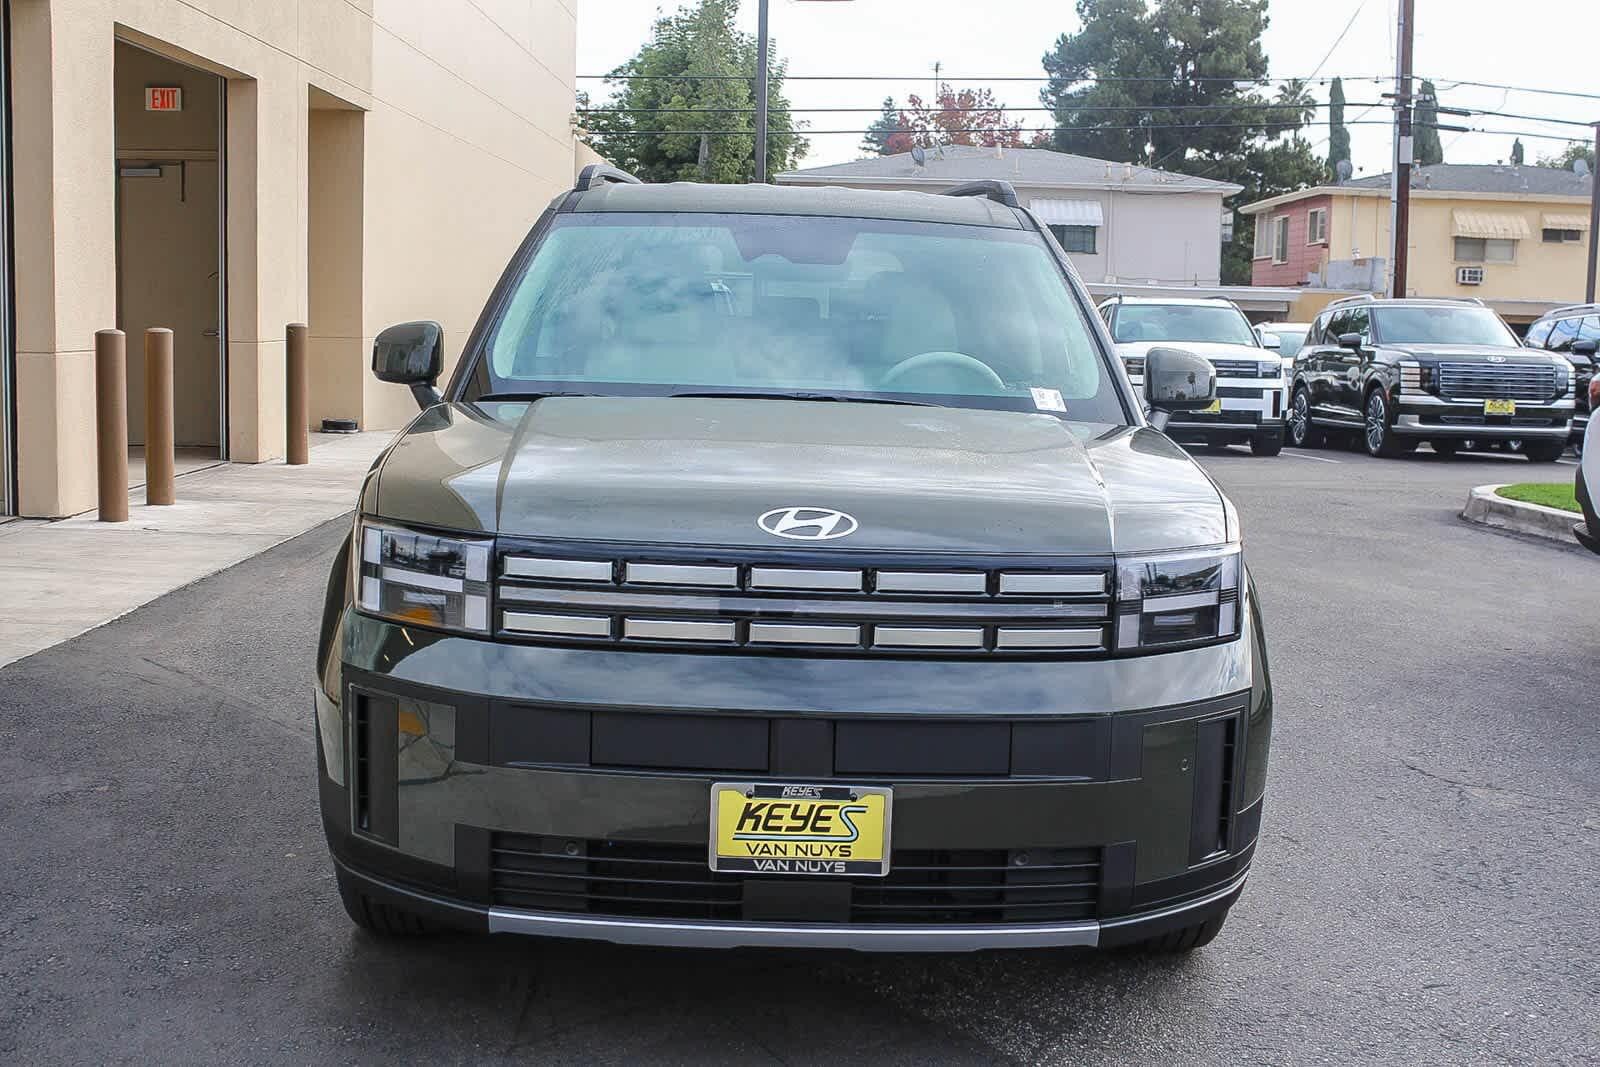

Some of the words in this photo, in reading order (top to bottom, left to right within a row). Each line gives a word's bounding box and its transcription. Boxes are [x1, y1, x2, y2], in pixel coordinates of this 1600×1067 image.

[151, 88, 177, 109] EXIT
[781, 786, 823, 799] KEYES
[733, 802, 869, 842] KEYES
[746, 843, 788, 857] VAN
[794, 844, 852, 858] NUYS
[753, 859, 788, 872] VAN
[795, 861, 846, 873] NUYS
